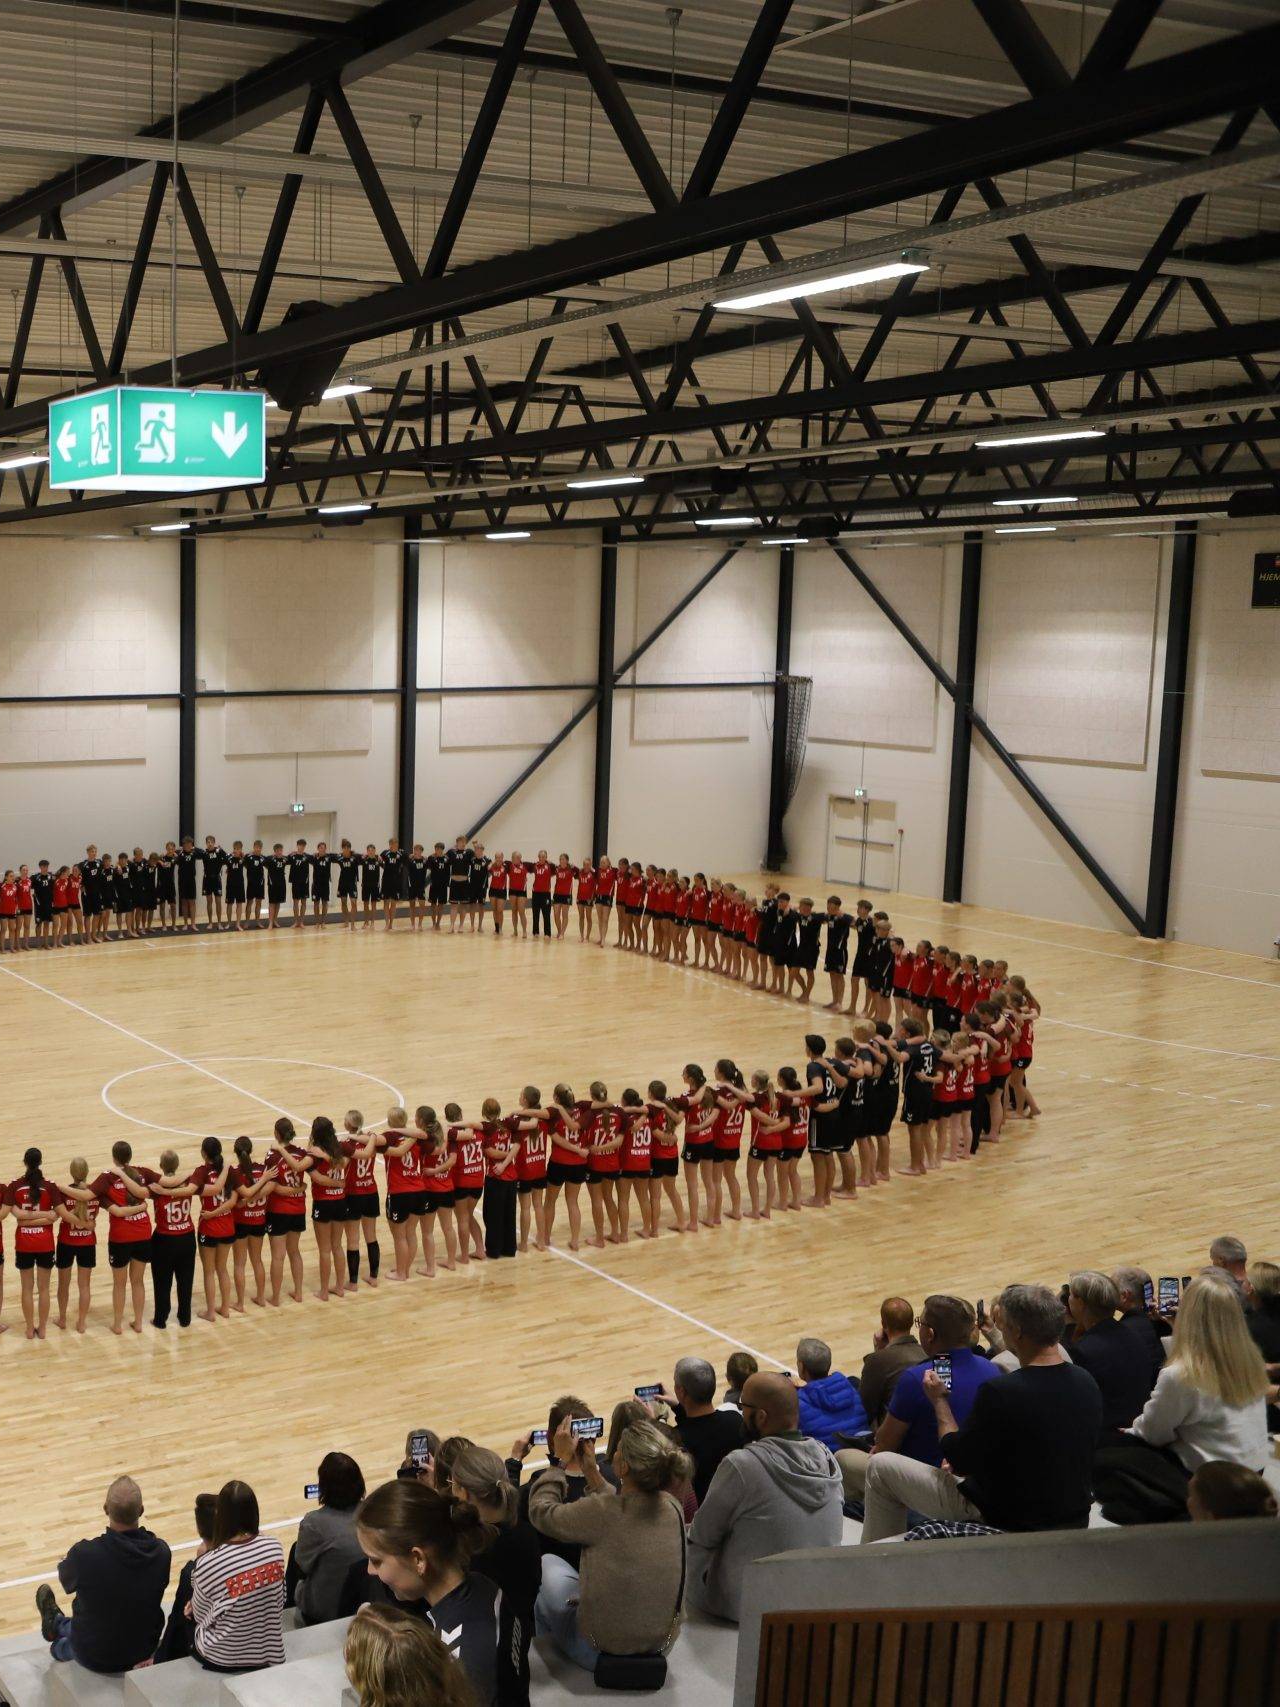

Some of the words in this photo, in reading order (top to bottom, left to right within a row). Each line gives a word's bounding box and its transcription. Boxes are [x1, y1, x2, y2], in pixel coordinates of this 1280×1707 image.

[632, 1126, 652, 1148] 150
[461, 1140, 484, 1166] 123
[164, 1198, 191, 1223] 159
